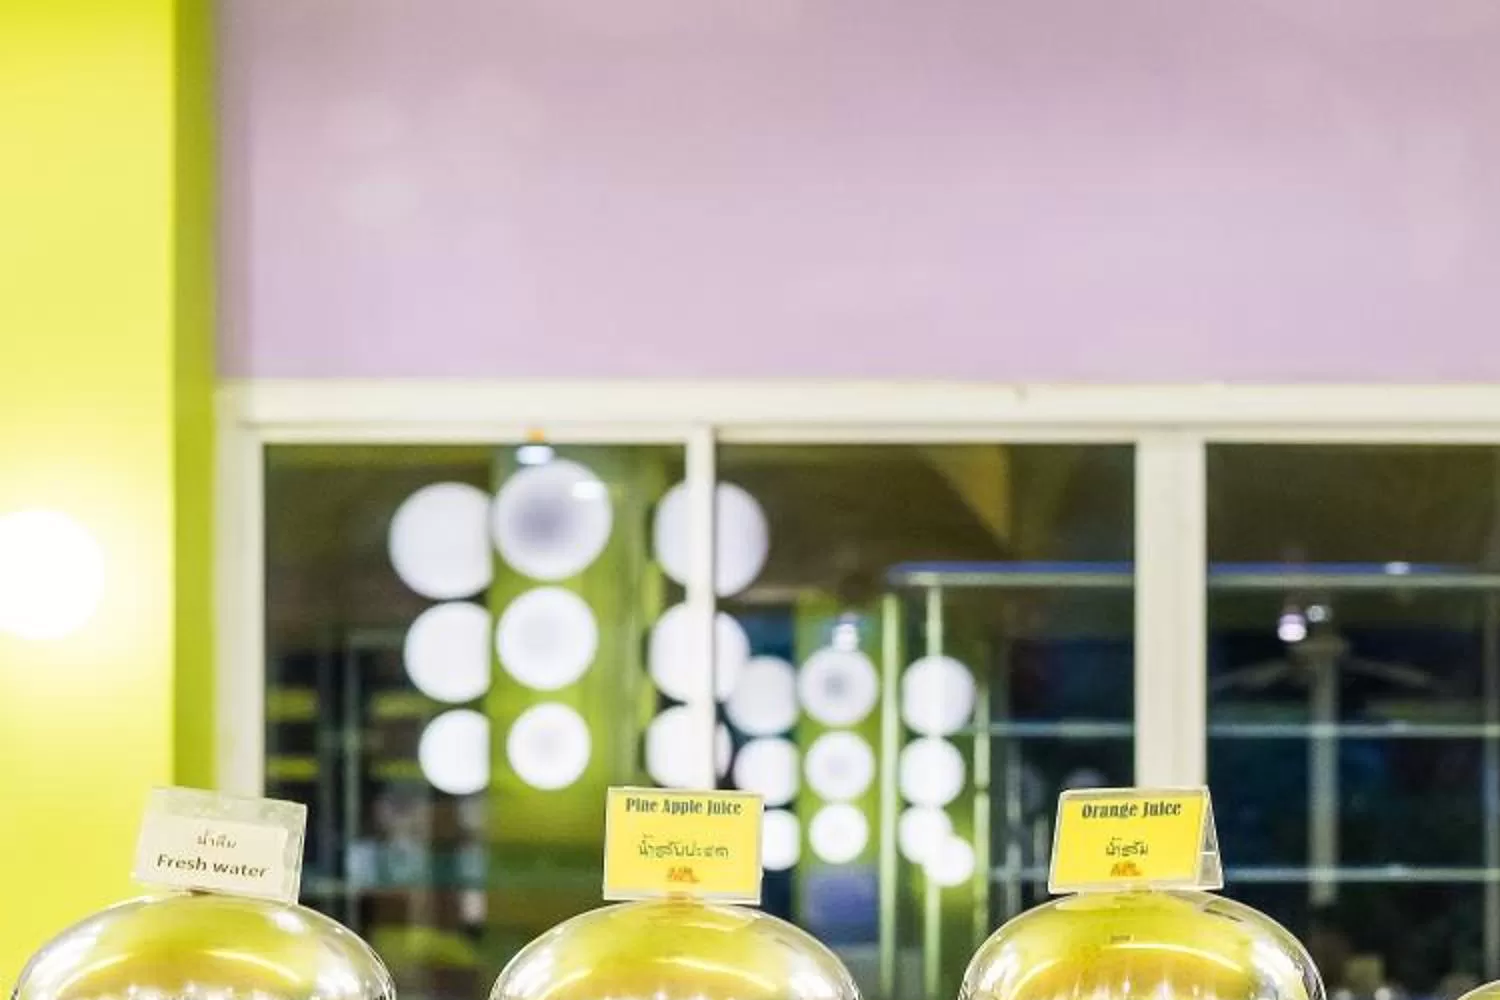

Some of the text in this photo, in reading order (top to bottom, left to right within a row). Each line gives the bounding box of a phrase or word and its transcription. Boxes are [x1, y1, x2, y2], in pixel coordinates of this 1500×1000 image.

[625, 797, 743, 817] Pine Apple Juice
[1081, 801, 1182, 819] Orange Juice
[156, 853, 268, 878] Fresh water
